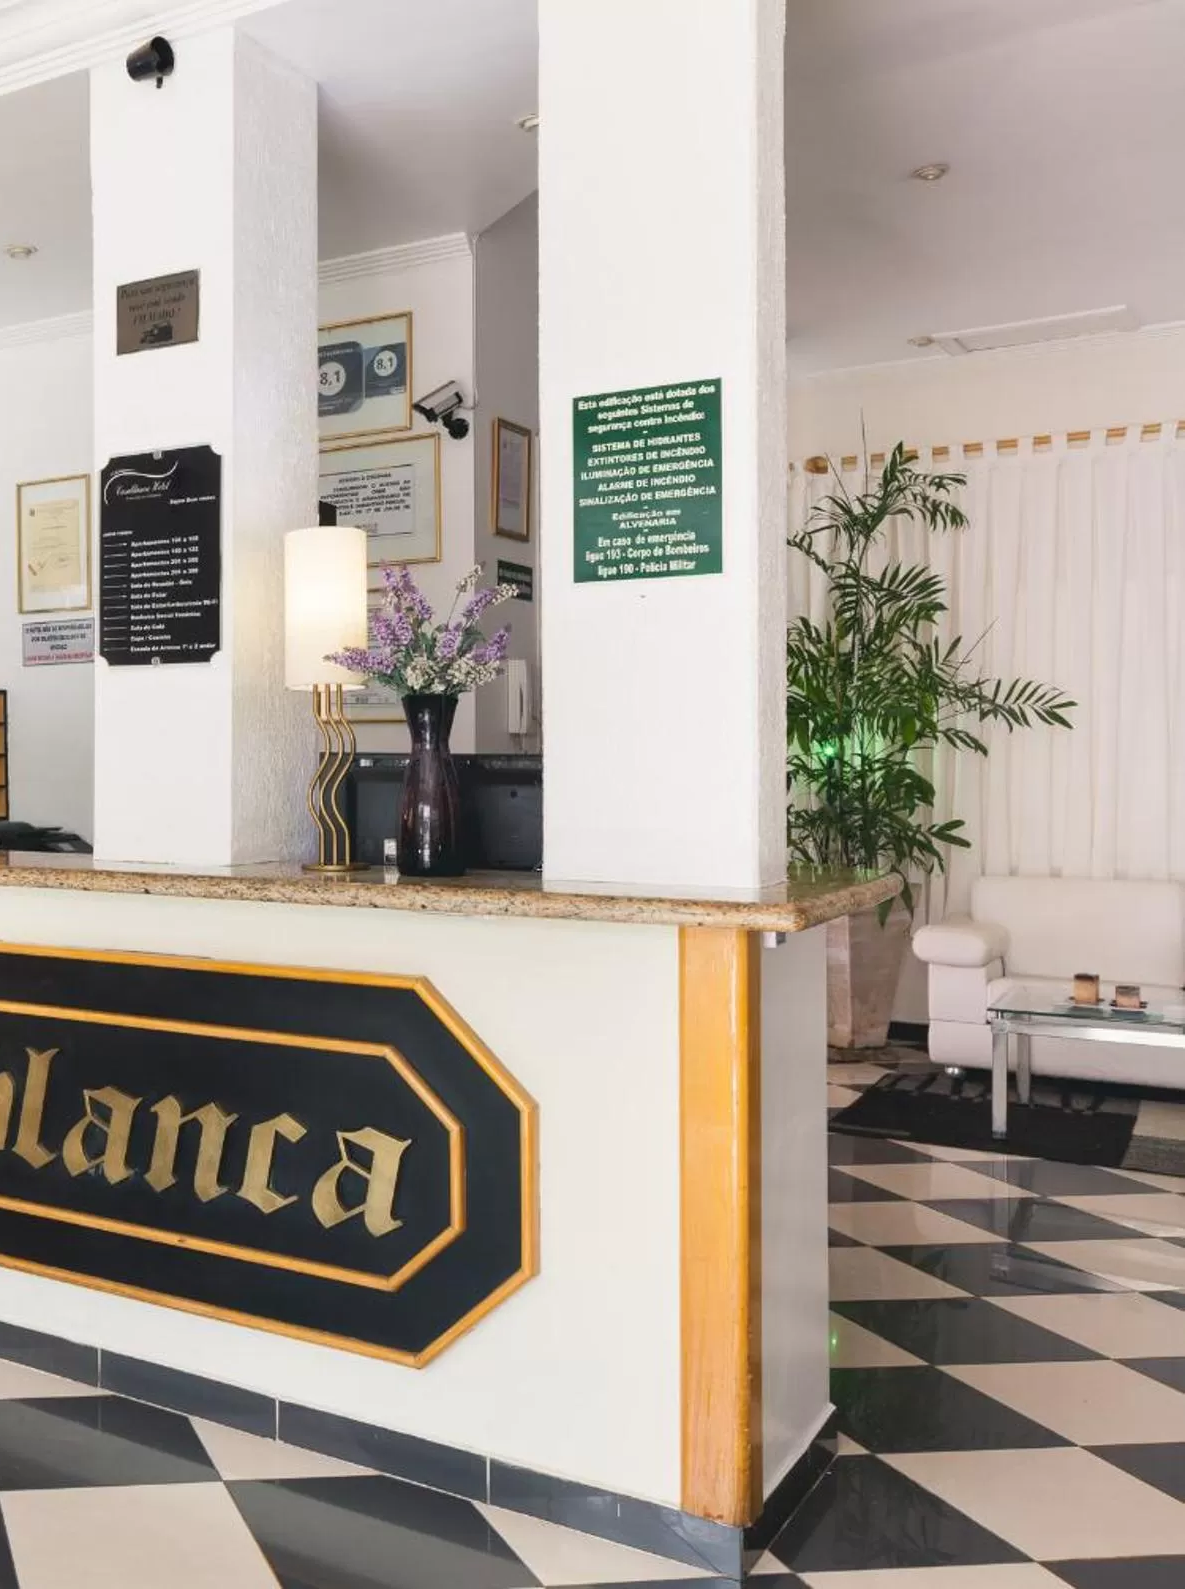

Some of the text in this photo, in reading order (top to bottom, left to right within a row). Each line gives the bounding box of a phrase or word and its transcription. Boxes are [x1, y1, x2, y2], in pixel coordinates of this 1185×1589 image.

[377, 356, 393, 370] 8,1
[320, 370, 340, 386] 8,1
[578, 385, 715, 410] Esta edificação está dotada dos
[597, 400, 694, 420] seguintes Sistemas de
[587, 421, 632, 434] segurança
[634, 417, 662, 427] contra
[592, 433, 701, 453] SISTEMA DE HIDRANTES
[587, 446, 706, 467] EXTINTORES DE INCÊNDIO
[581, 458, 714, 480] ILUMINAÇÃO DE EMERGÊNCIA
[598, 474, 696, 492] ALARME DE INCÊNDIO
[579, 486, 716, 507] SINALIZAÇÃO DE EMERGÊNCIA
[612, 510, 663, 520] Edificação
[619, 517, 677, 529] ALVENARIA
[598, 530, 696, 547] Em caso de emergência
[586, 551, 604, 563] ligue
[606, 549, 621, 560] 193
[627, 547, 652, 559] Corpo
[653, 545, 664, 556] de
[665, 543, 710, 556] Bombeiros
[598, 565, 617, 578] ligue
[619, 563, 634, 574] 190
[670, 560, 696, 571] Militar
